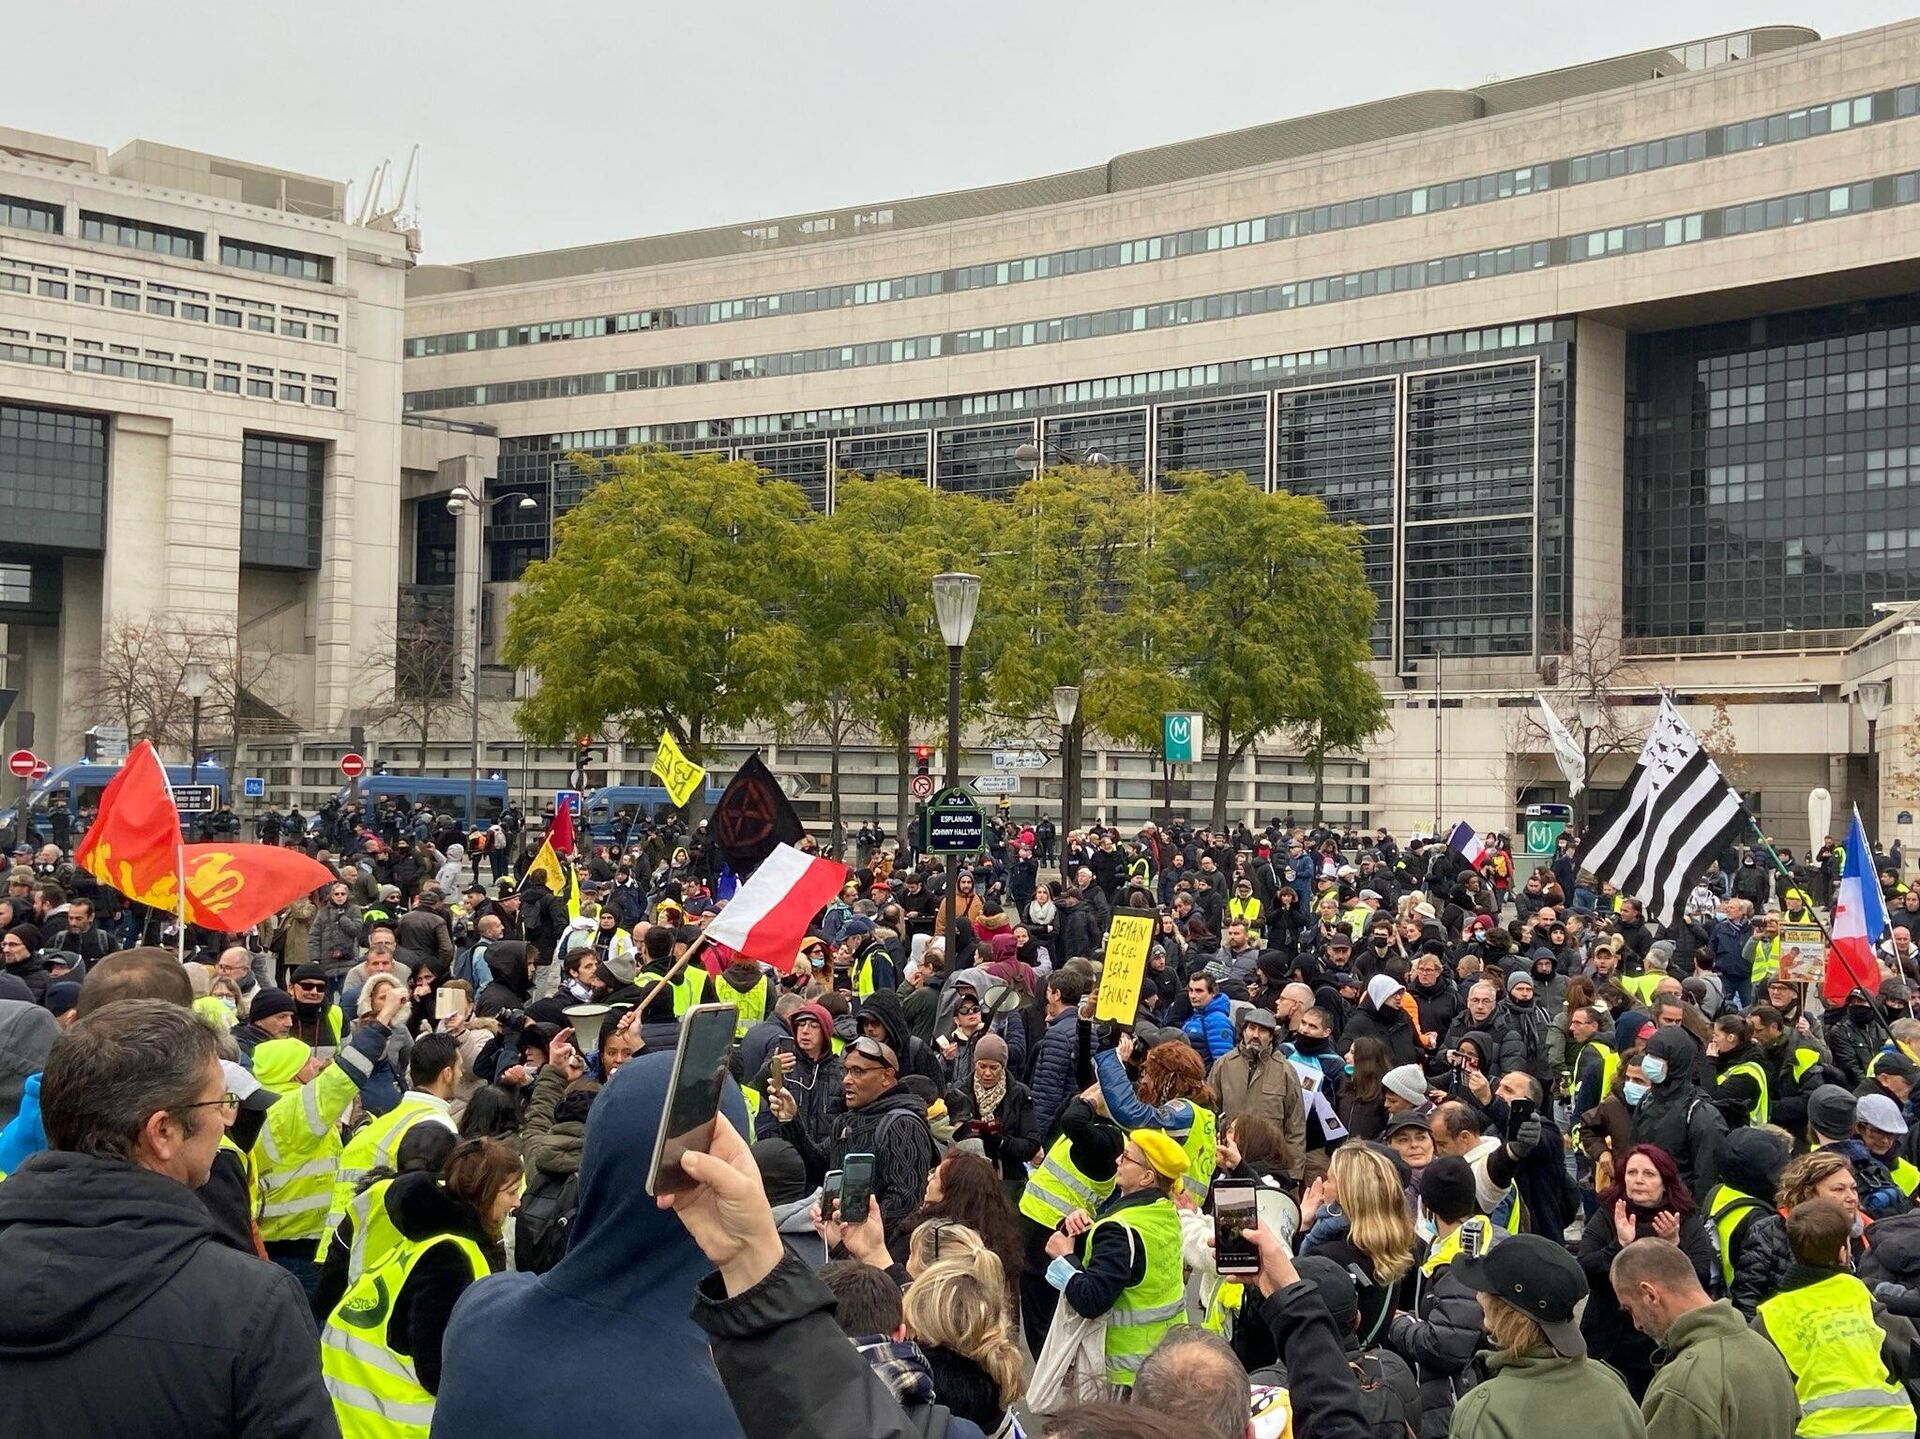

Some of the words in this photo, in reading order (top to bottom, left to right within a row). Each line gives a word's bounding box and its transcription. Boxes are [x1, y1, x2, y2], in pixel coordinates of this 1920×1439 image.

[940, 815, 973, 823] ESPLANADE
[931, 828, 953, 836] JOHNNY
[953, 828, 982, 836] HALLYDAY
[1122, 944, 1136, 959] CIEL
[1108, 961, 1129, 980] SERA
